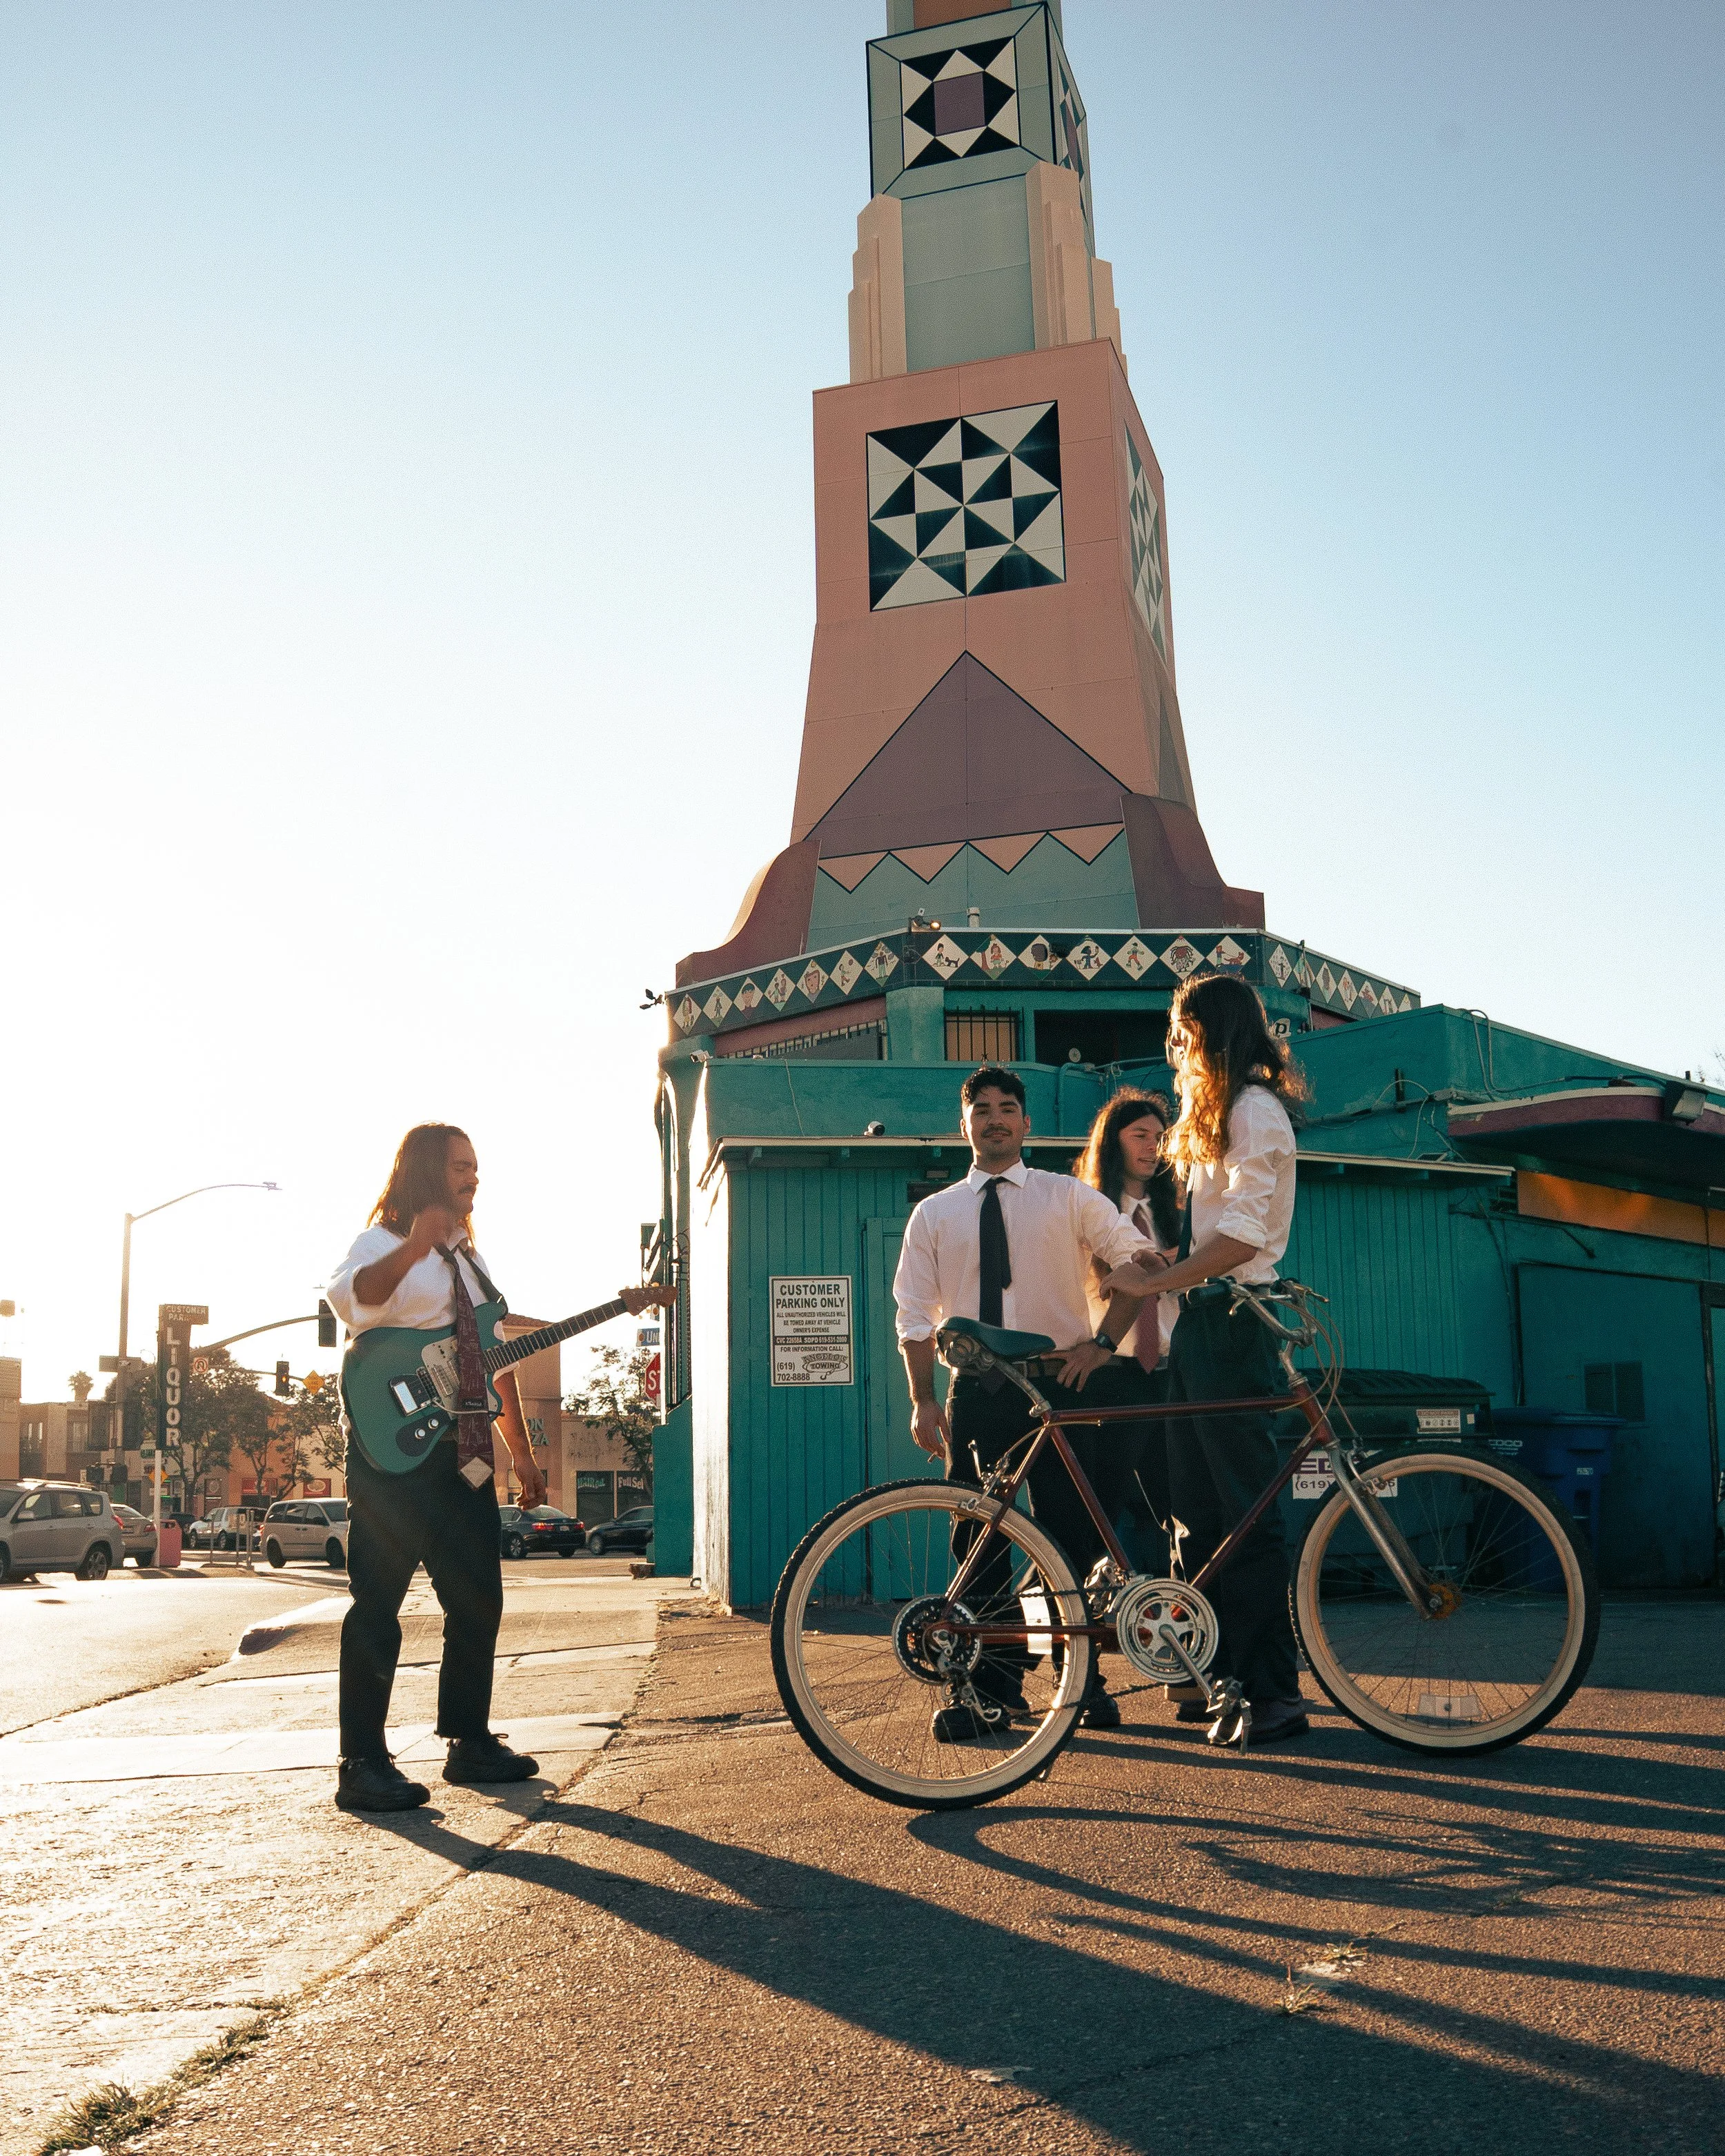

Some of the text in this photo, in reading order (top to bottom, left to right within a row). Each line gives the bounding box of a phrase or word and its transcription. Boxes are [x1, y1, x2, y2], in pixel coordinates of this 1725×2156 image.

[780, 1284, 840, 1296] CUSTOMER
[776, 1297, 845, 1309] PARKING ONLY
[777, 1362, 796, 1372] (619)
[777, 1373, 811, 1381] 702-8888
[166, 1326, 181, 1447] LIQUOR
